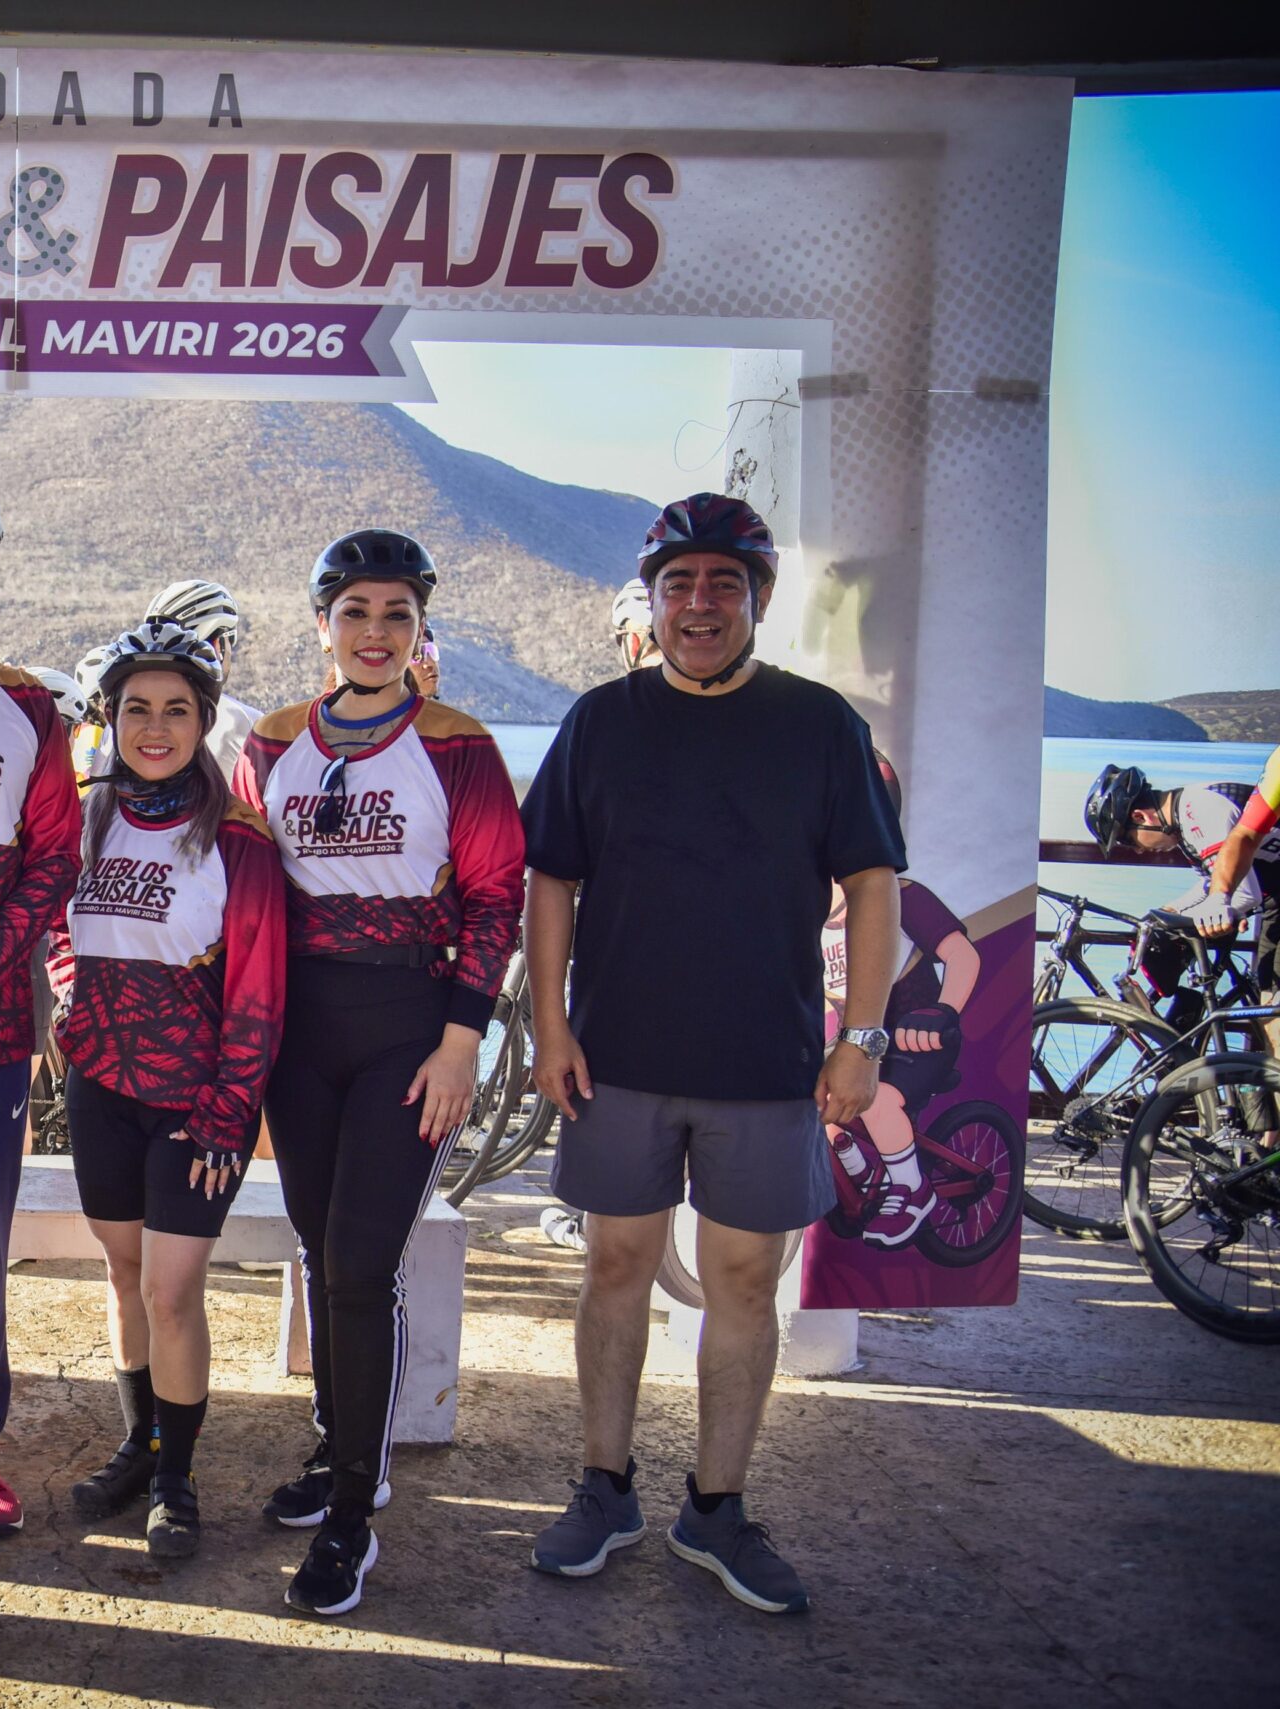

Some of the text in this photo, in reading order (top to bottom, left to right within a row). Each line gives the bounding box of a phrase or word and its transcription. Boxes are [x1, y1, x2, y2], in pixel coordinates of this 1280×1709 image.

[88, 151, 674, 289] PAISAJES
[40, 319, 218, 357] MAVIRI
[229, 321, 346, 360] 2026
[285, 820, 296, 836] &
[92, 857, 173, 884] UEBLOS
[80, 879, 176, 909] PAISAJES
[114, 908, 141, 916] MAVIRI
[141, 910, 160, 919] 2026
